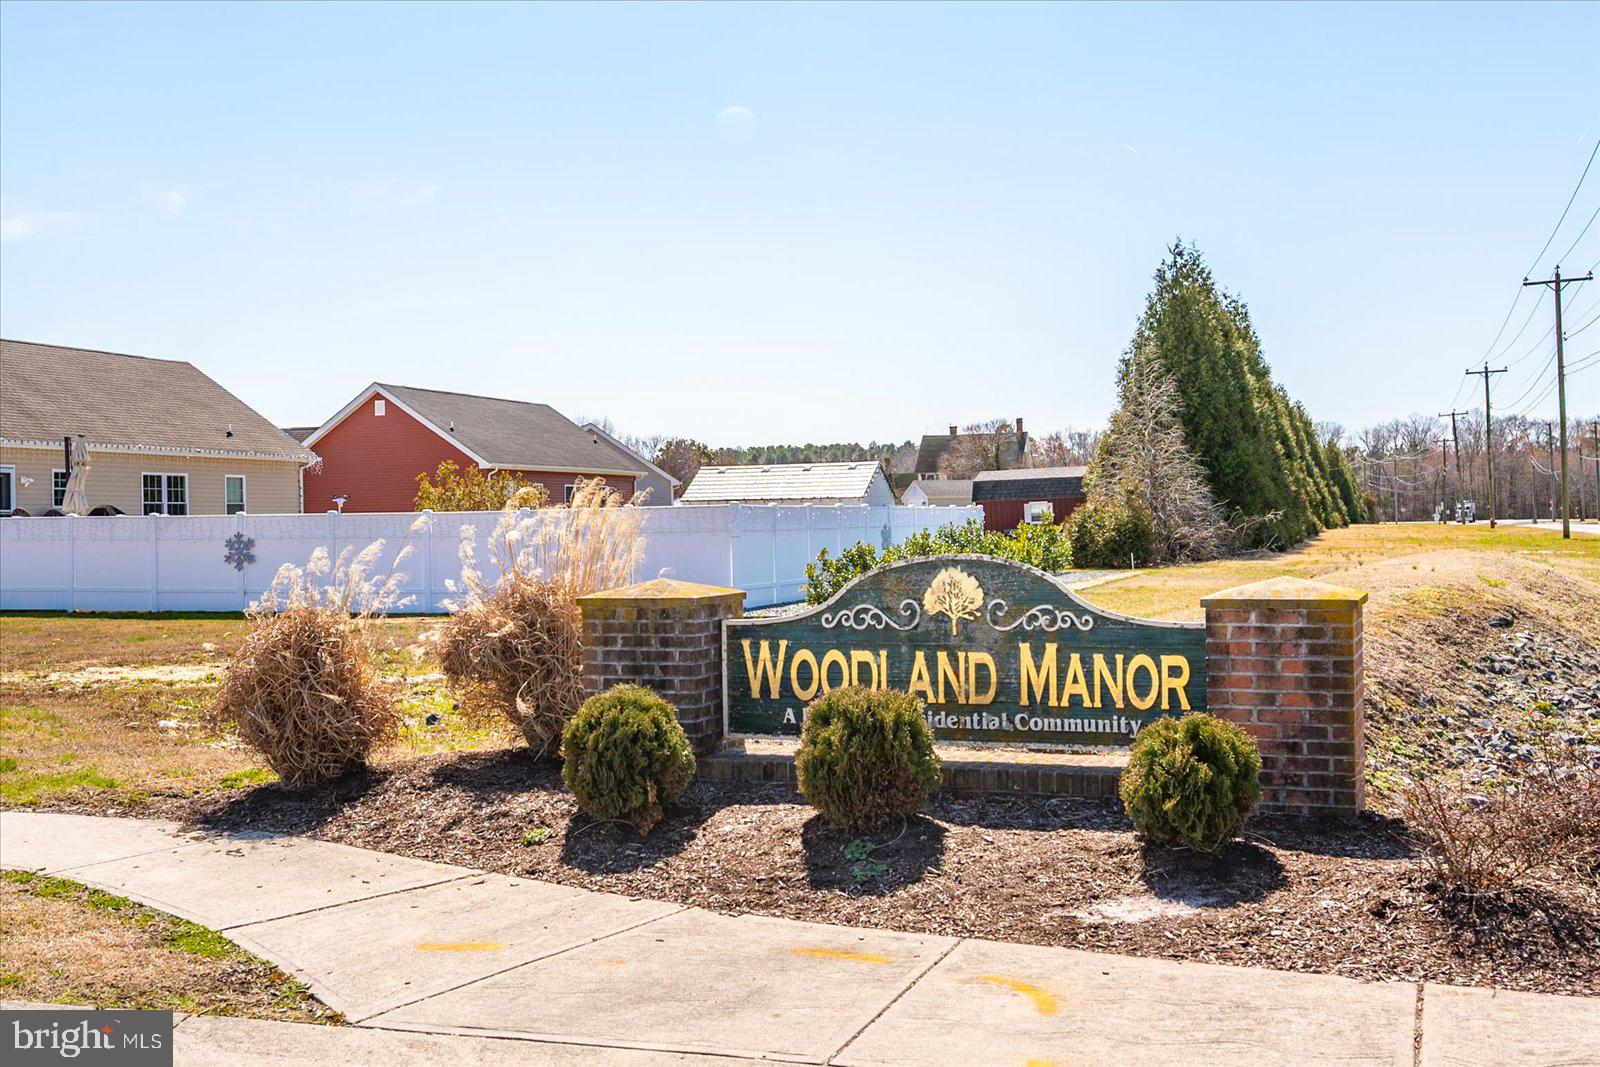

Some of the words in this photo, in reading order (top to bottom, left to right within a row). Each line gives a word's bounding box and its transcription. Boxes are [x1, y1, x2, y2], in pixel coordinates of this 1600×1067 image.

[1019, 642, 1192, 711] MANOR
[782, 706, 797, 724] A
[1014, 712, 1142, 738] Community
